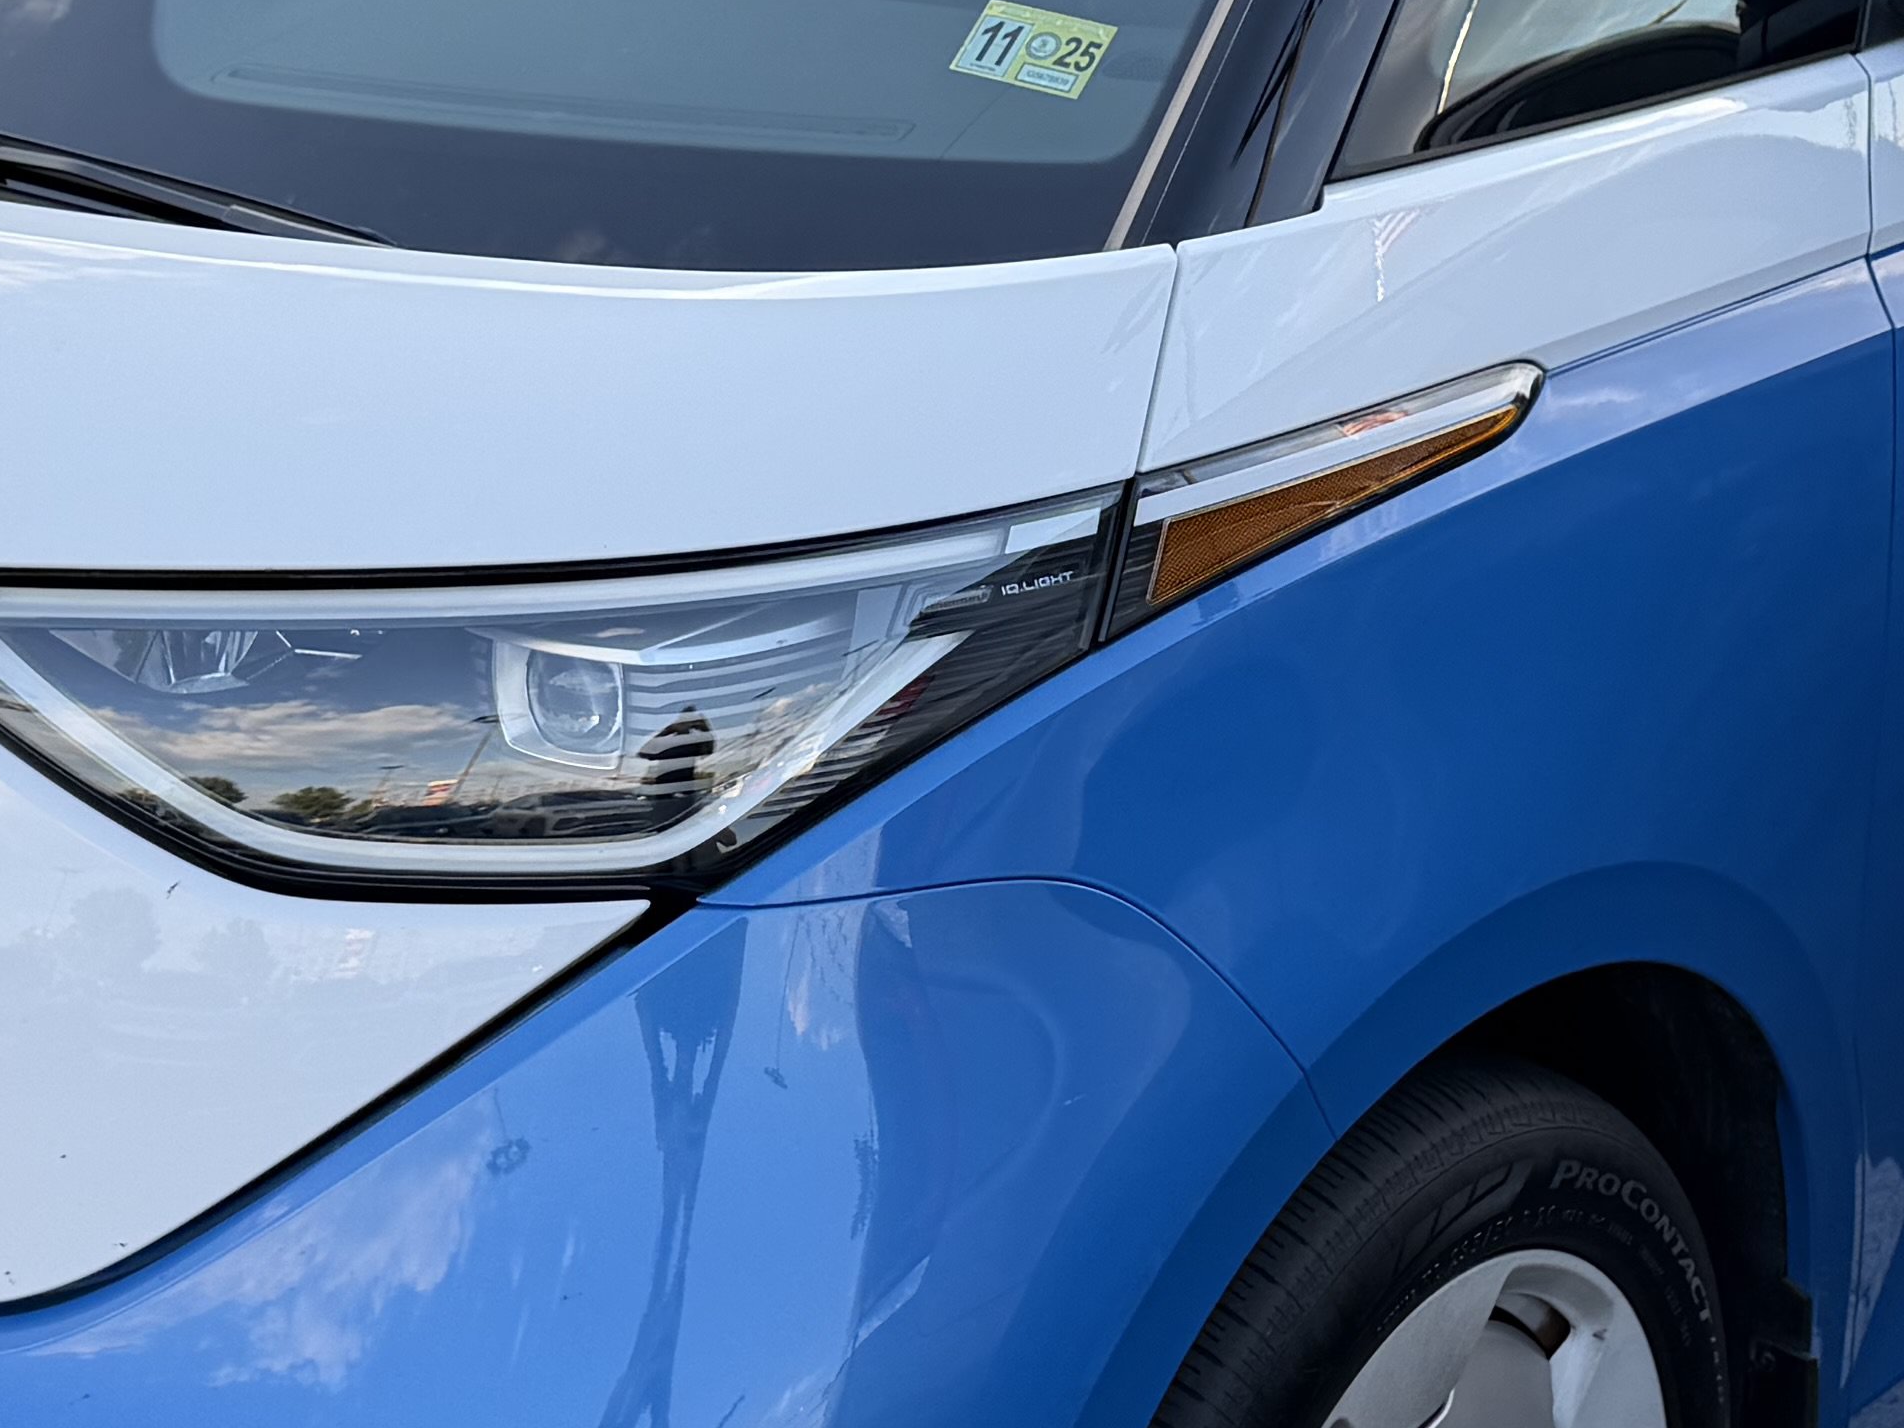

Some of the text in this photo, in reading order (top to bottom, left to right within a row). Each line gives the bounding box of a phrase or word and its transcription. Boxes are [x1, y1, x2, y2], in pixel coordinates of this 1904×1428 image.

[975, 20, 1104, 72] 11 25
[1000, 570, 1075, 596] IQ.LIGHT
